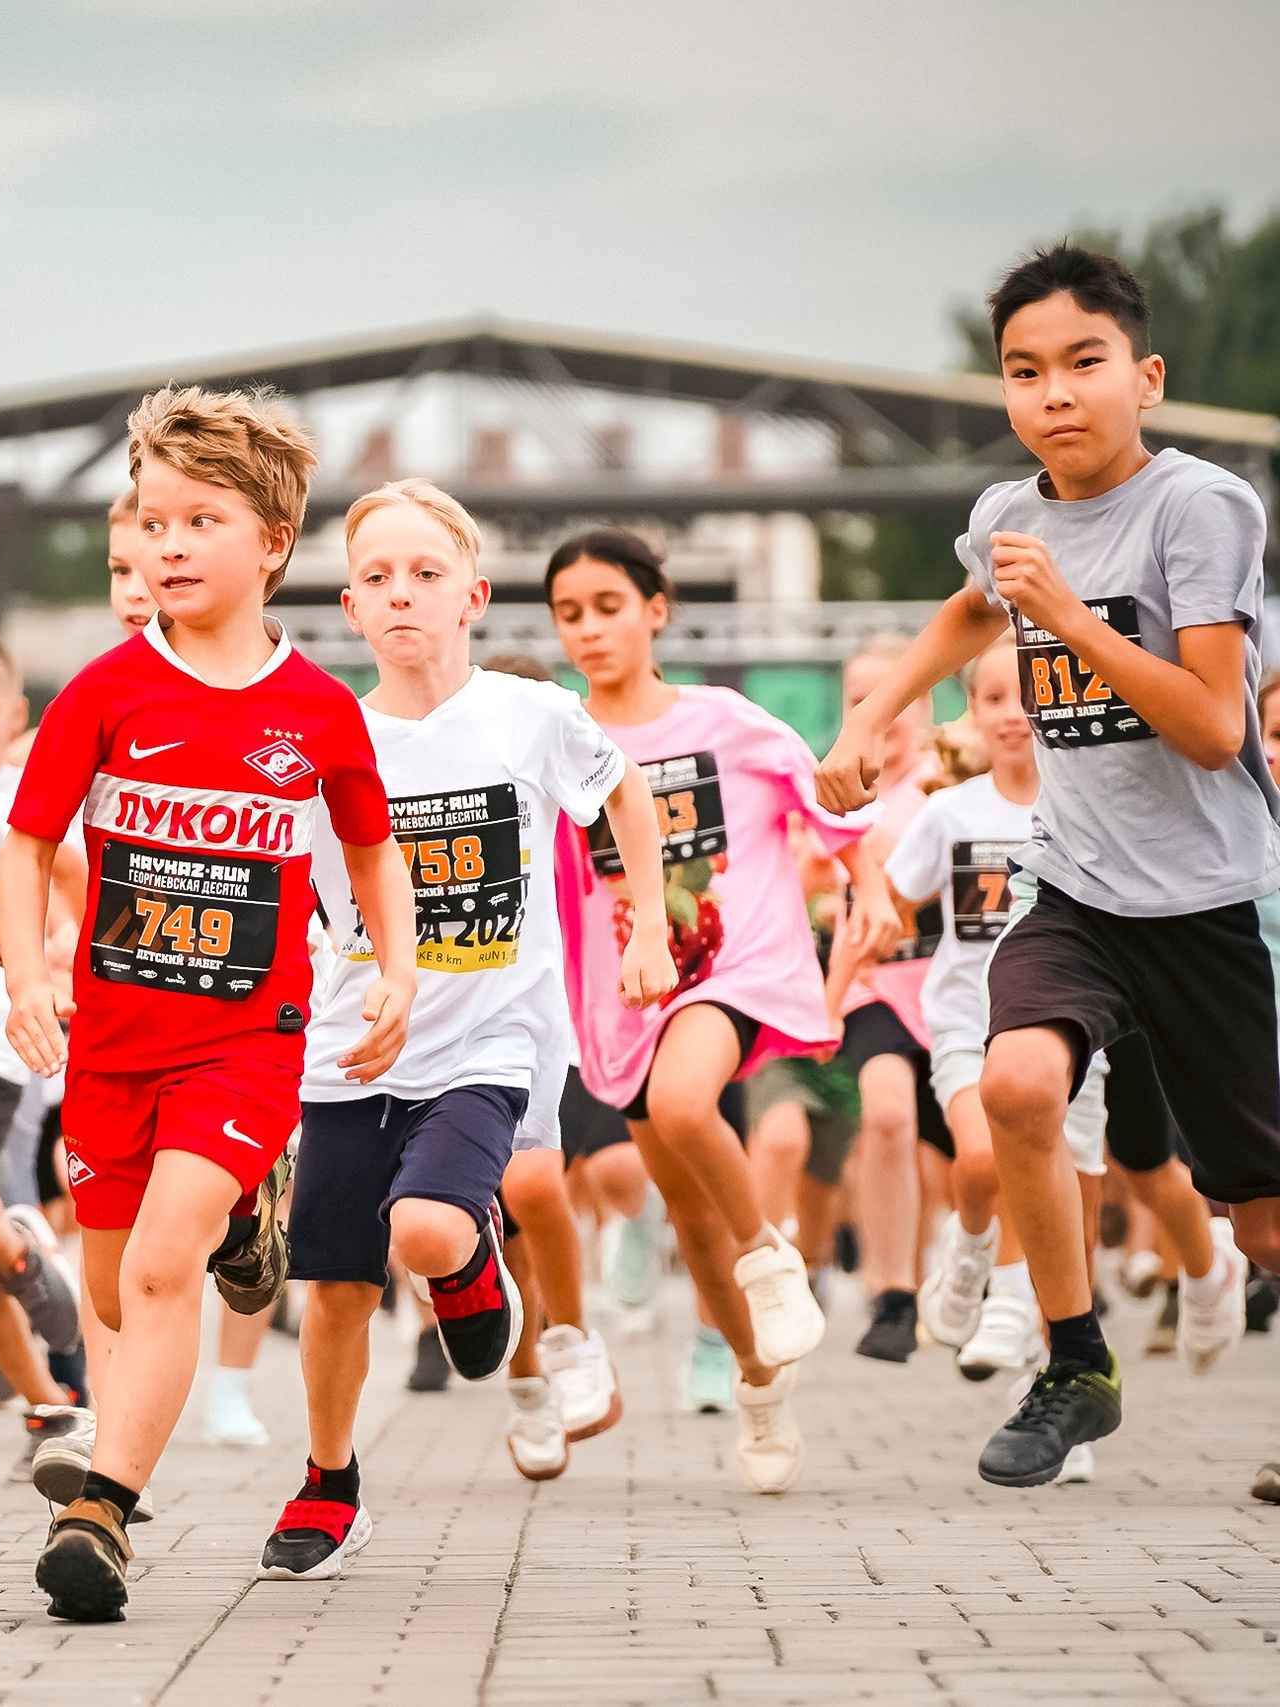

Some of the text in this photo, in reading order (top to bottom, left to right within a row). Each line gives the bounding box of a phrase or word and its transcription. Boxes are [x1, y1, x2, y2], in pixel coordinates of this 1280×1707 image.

[1031, 655, 1112, 706] 812
[1076, 704, 1107, 717] ЗАБЕГ
[115, 791, 294, 852] ЛУКОЙЛ
[390, 808, 489, 830] РГИЕВСКАЯ ДЕСЯТКА
[400, 835, 485, 884] 758
[128, 868, 249, 898] ГЕОРГИЕВСКАЯ ДЕСЯТКА
[413, 881, 481, 897] ТСКИЙ ЗАБЕГ
[135, 897, 234, 956] 749
[135, 948, 224, 971] ДЕТСКИЙ ЗАБЕГ
[436, 951, 443, 962] 8
[445, 951, 463, 965] km
[478, 950, 500, 963] RUN
